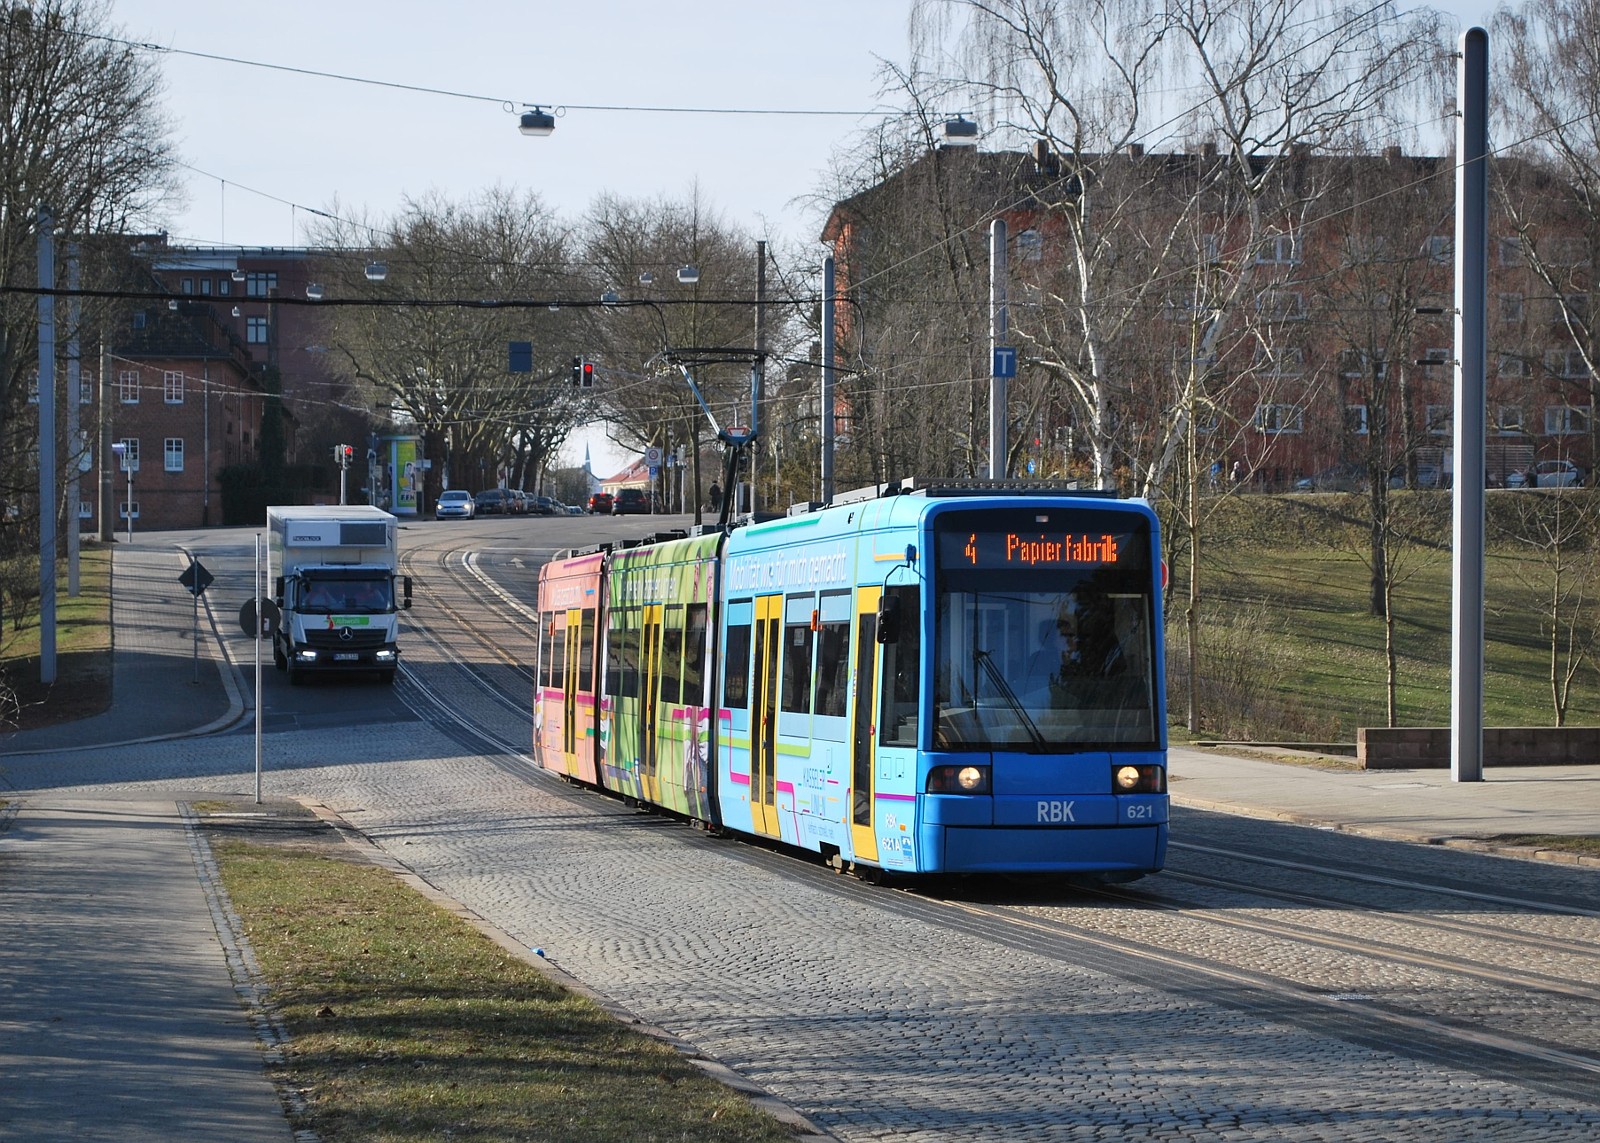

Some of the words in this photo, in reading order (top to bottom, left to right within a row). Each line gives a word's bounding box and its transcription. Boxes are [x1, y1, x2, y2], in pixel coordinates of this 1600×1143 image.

[997, 351, 1012, 374] T
[965, 533, 976, 565] 4
[1037, 801, 1075, 822] RBK
[1127, 805, 1152, 819] 621
[882, 837, 901, 852] 621A
